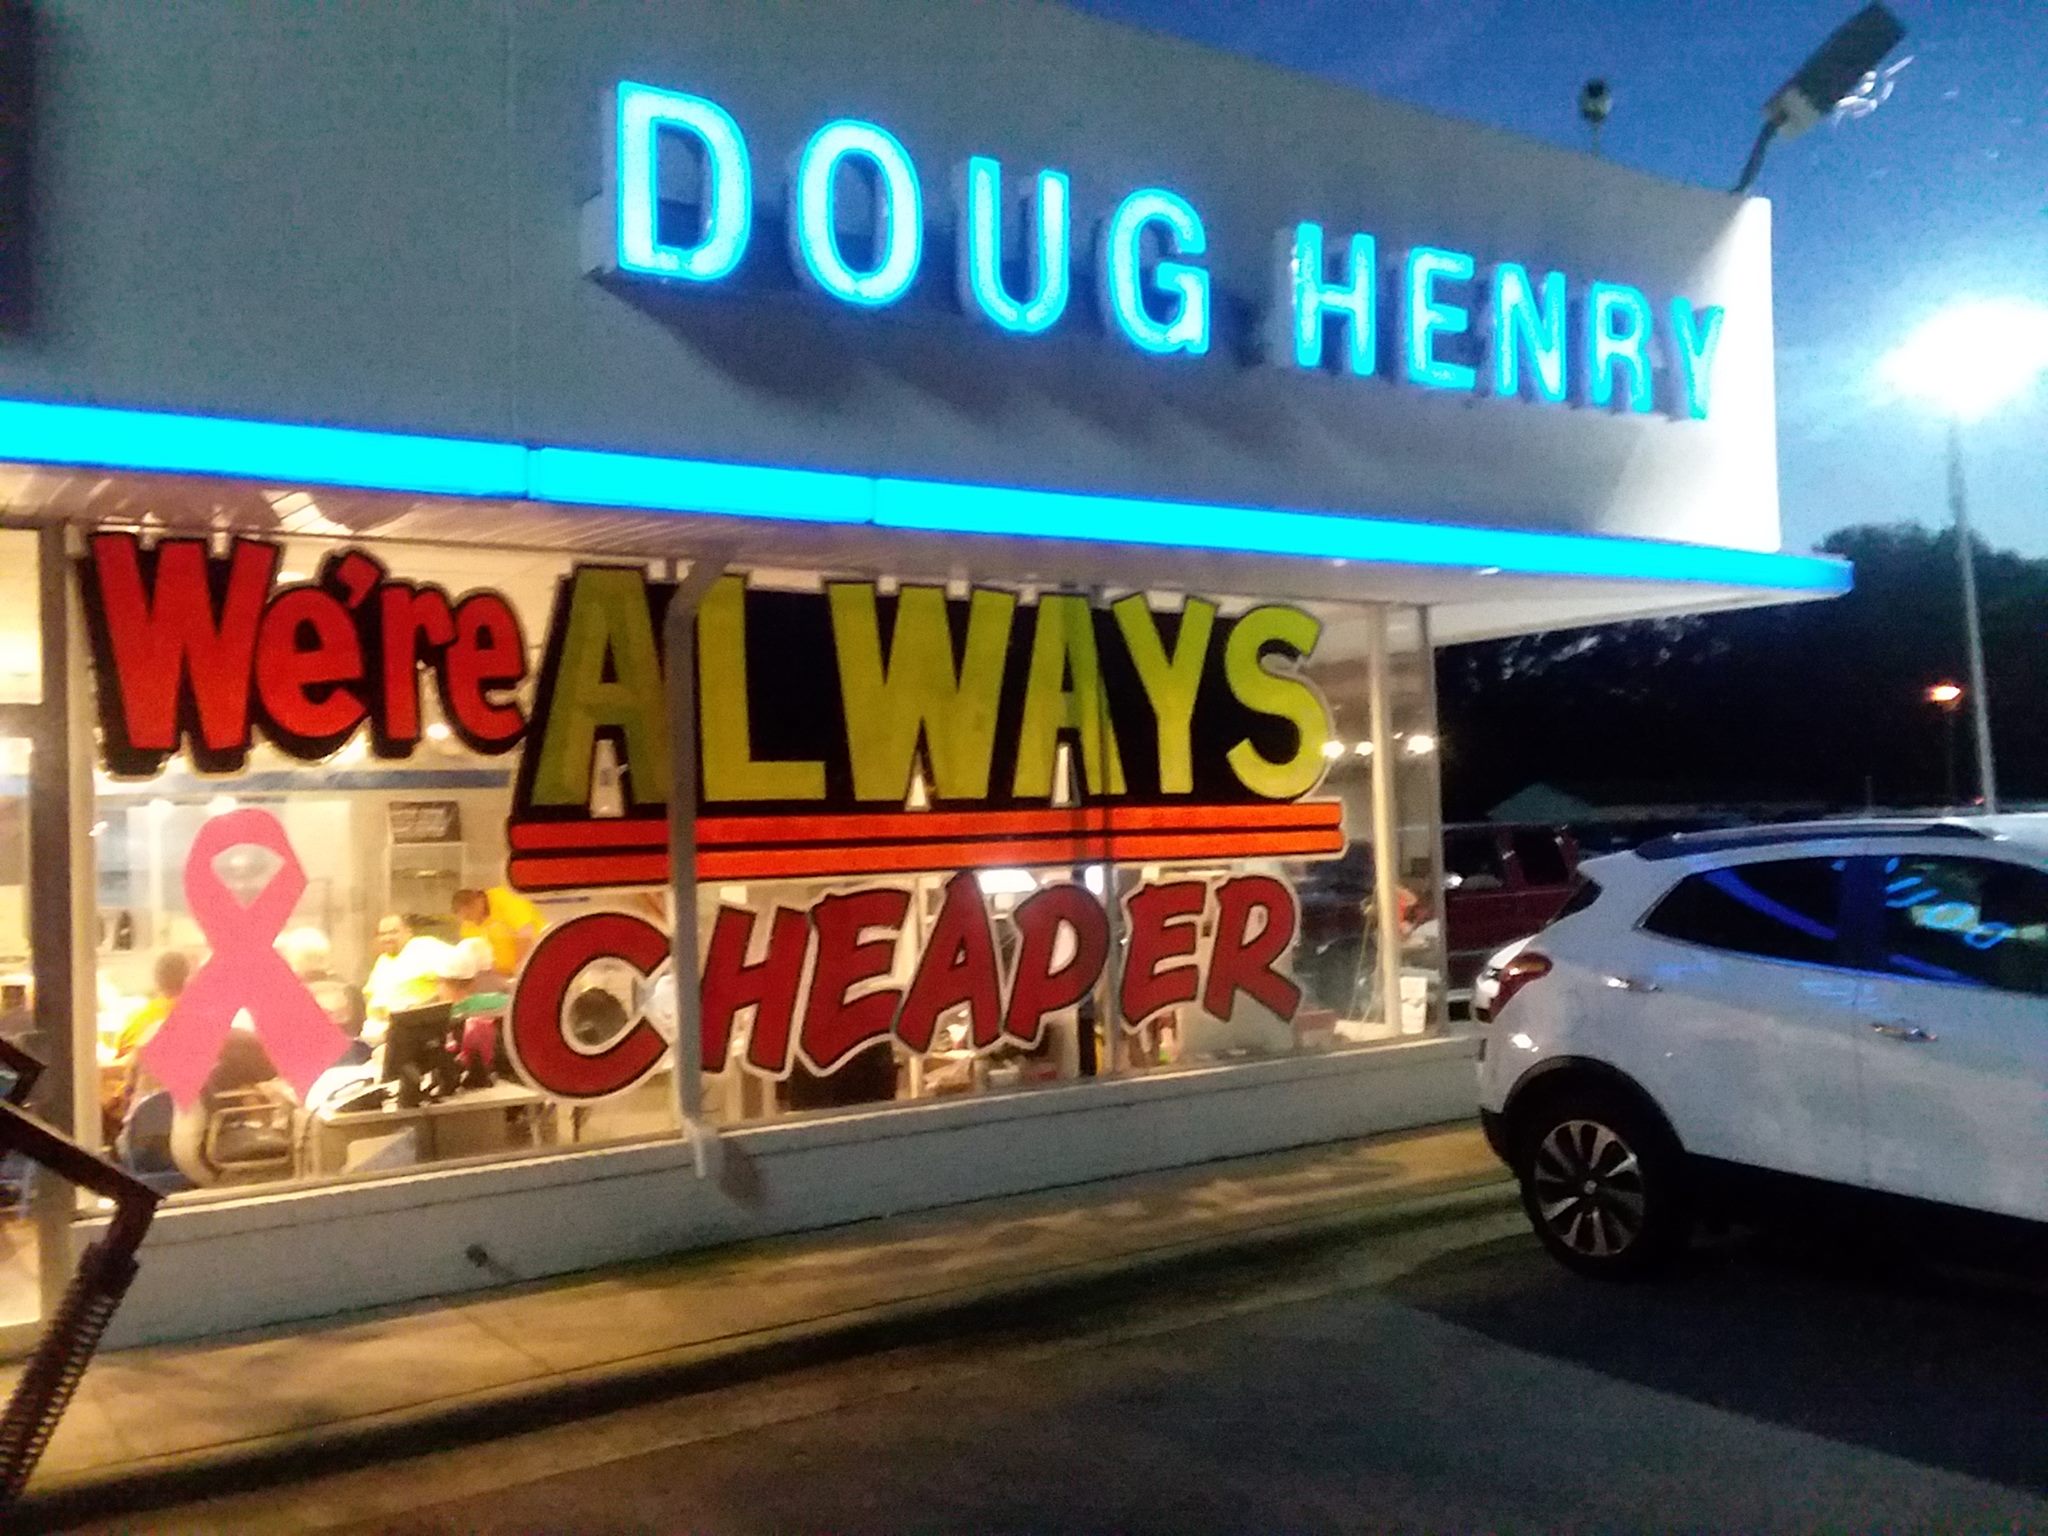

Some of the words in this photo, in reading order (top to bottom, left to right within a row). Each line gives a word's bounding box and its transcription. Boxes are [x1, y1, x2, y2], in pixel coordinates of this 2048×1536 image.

[615, 80, 1212, 356] DOUG
[1291, 221, 1726, 421] HENRY
[90, 530, 527, 758] We're
[528, 564, 1330, 804] ALWAYS
[513, 872, 1302, 1098] CHEAPER
